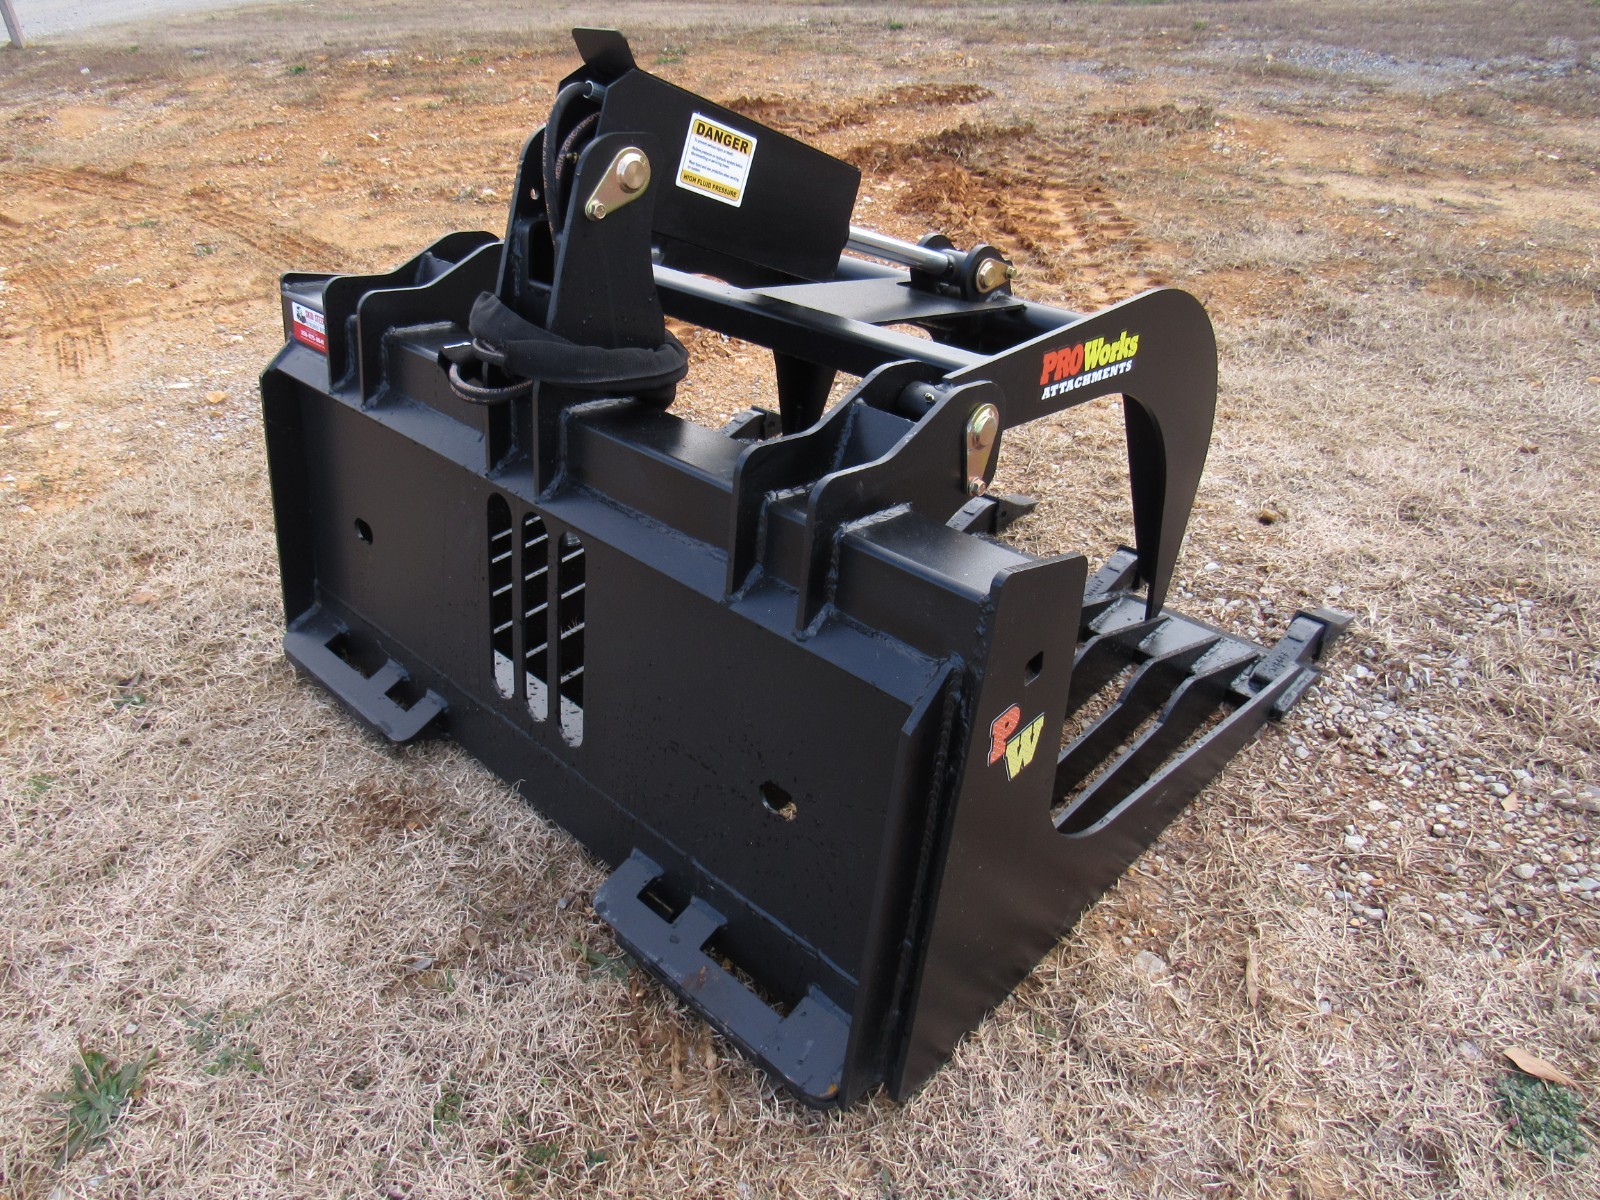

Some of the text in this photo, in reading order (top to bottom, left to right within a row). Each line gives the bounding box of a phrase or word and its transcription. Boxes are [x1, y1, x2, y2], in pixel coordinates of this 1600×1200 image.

[696, 122, 748, 154] DANGER
[683, 174, 737, 198] HIGH FLUID PRESSURE
[1040, 330, 1139, 386] PROWorks
[1041, 359, 1133, 401] ATTACHMENTS
